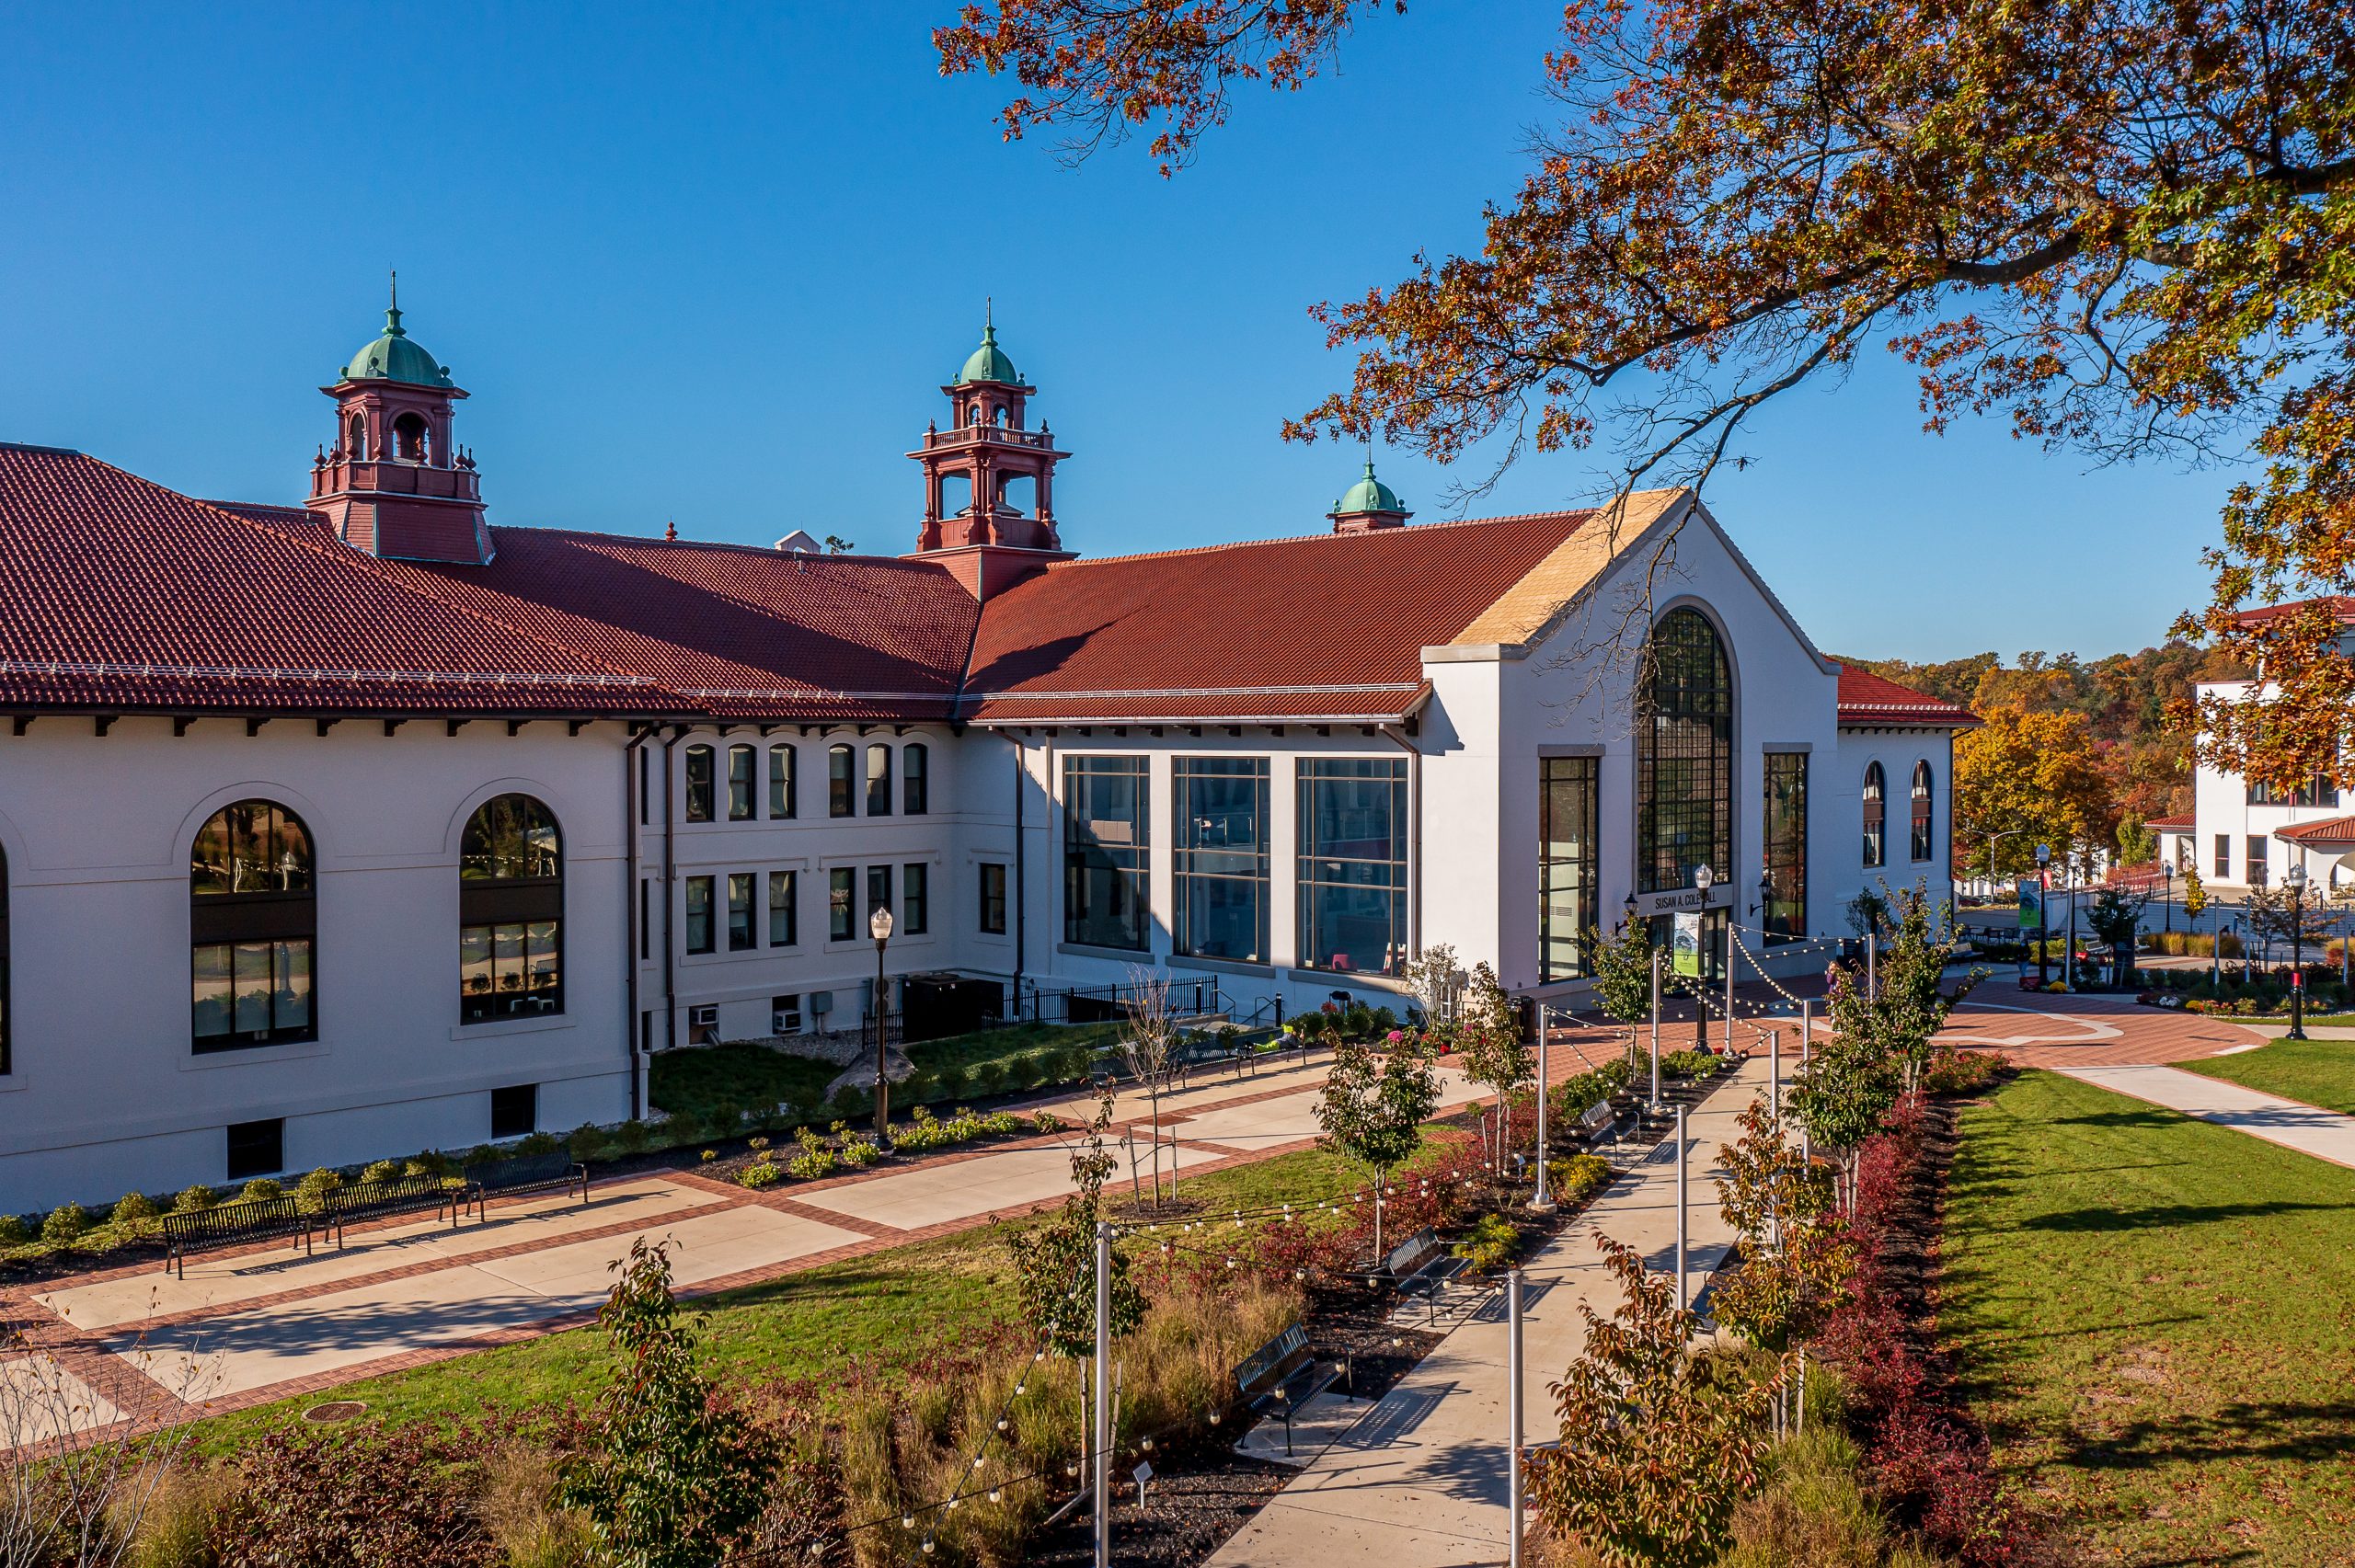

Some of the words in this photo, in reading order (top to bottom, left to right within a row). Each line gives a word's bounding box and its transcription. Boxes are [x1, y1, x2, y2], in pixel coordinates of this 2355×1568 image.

[1655, 896, 1676, 910] SUSAN
[1678, 896, 1684, 907] A.
[1685, 893, 1700, 906] COLE
[1705, 892, 1717, 903] ALL
